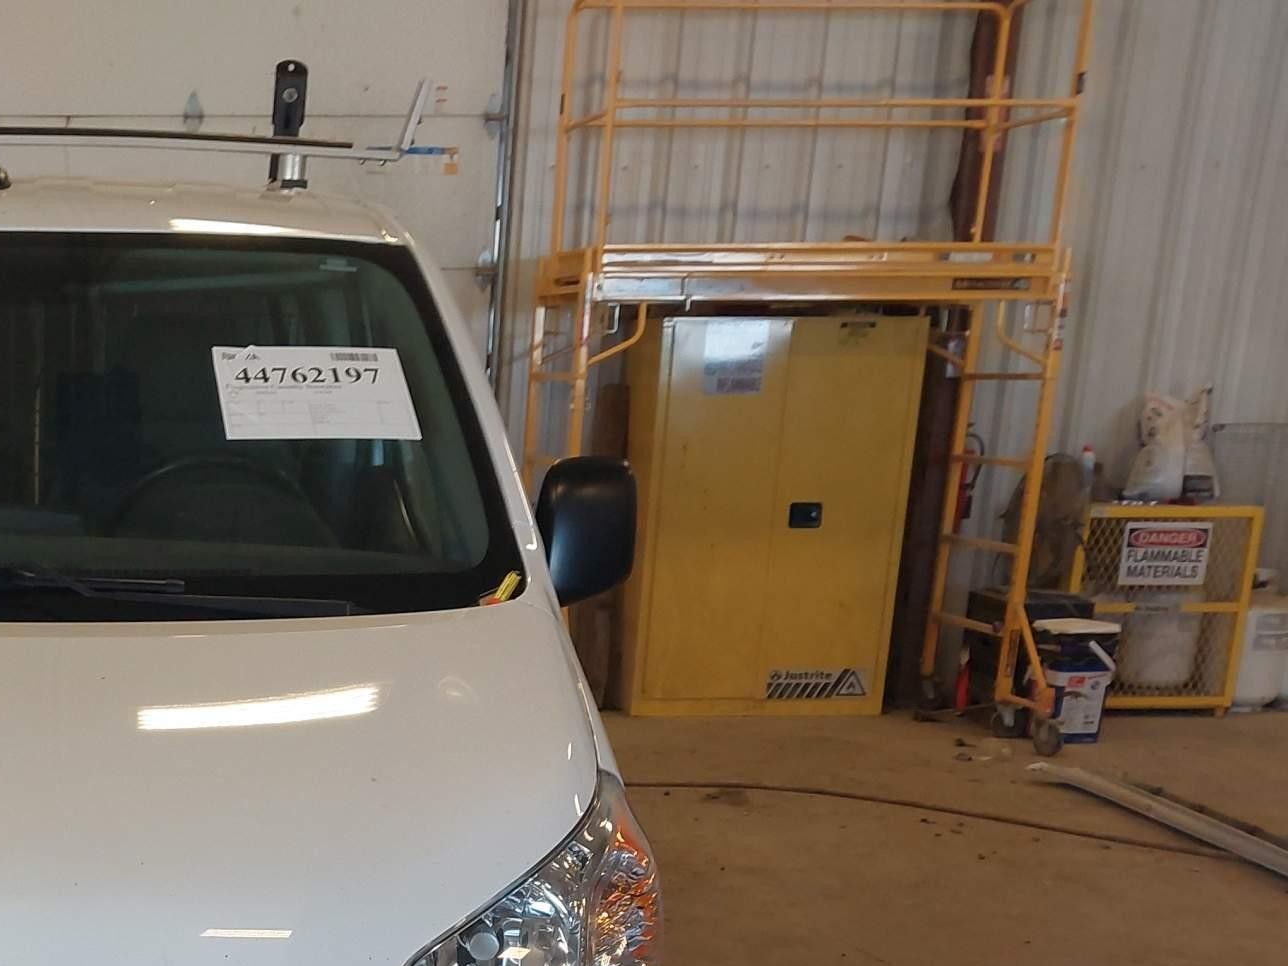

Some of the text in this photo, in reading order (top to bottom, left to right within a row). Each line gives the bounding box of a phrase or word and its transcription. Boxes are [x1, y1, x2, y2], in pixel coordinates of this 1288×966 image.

[234, 366, 381, 385] 44762197
[1138, 532, 1198, 544] DANGER
[1126, 549, 1205, 563] FLAMMABLE
[1125, 564, 1199, 579] MATERIALS
[784, 670, 833, 681] Justrite
